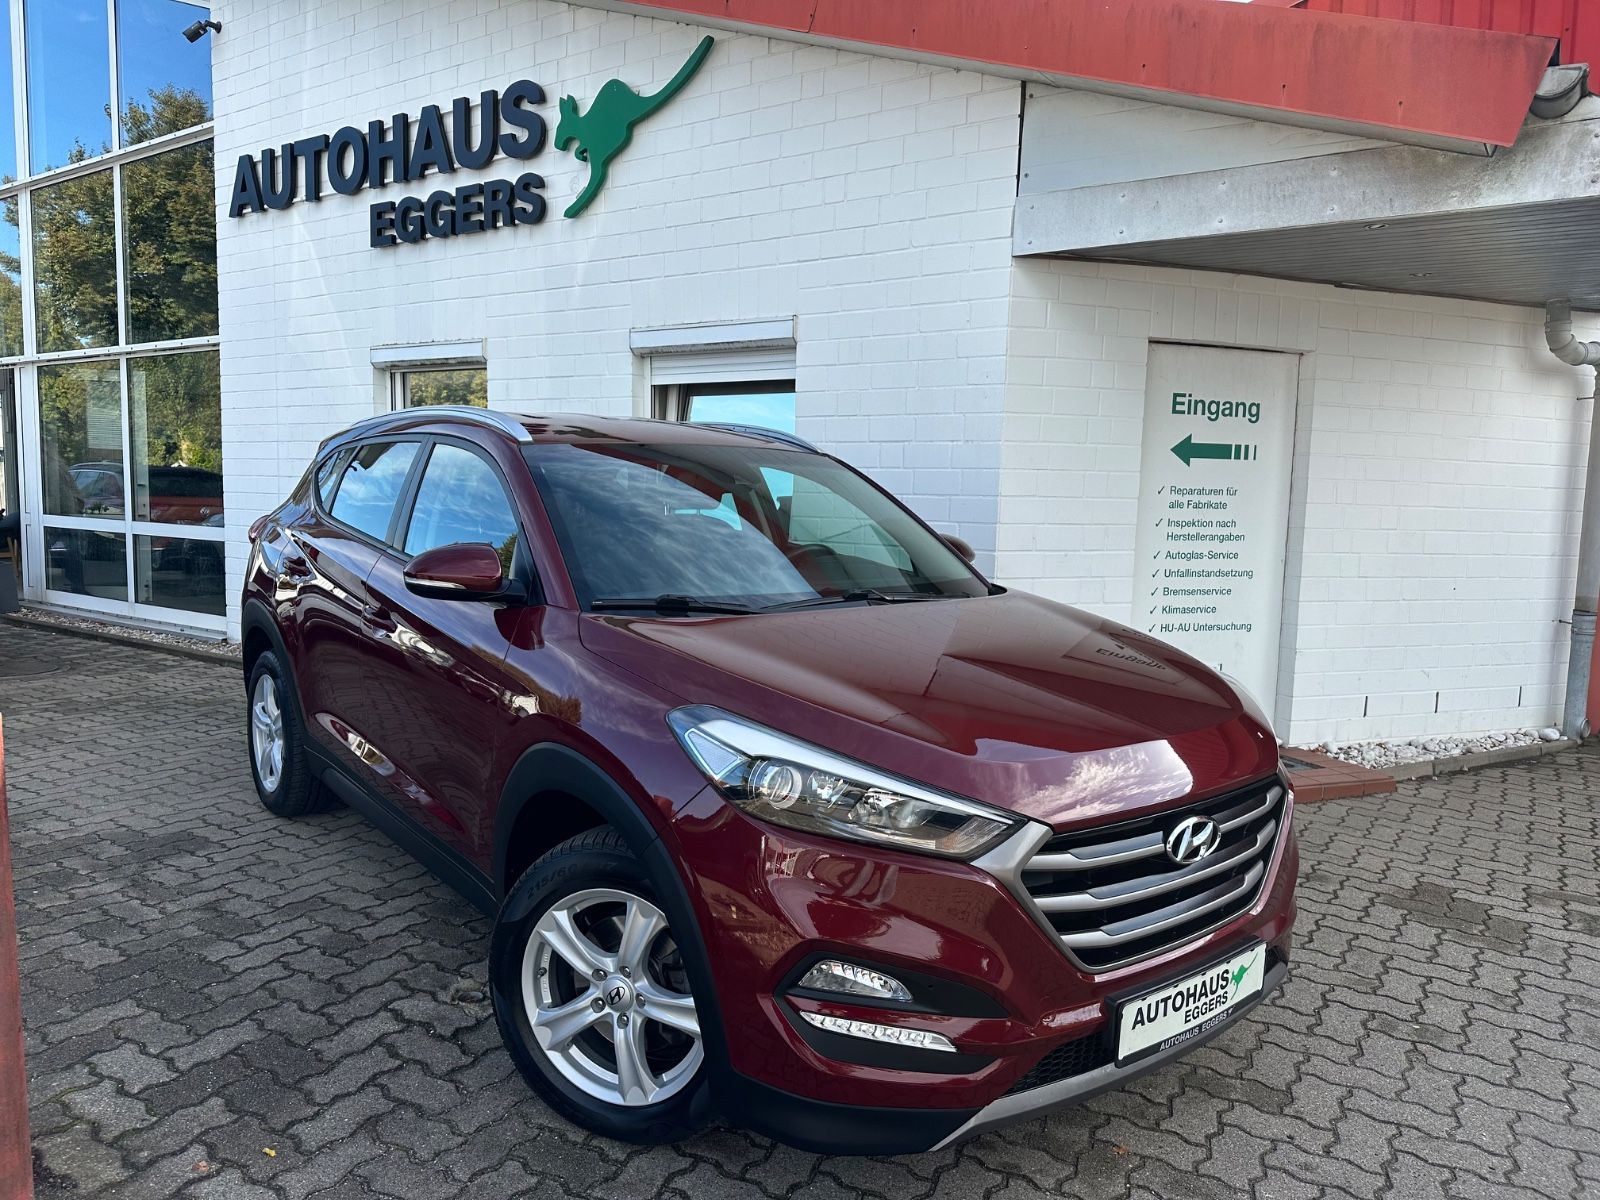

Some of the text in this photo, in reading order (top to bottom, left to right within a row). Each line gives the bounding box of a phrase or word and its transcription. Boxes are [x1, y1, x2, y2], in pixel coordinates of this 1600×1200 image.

[229, 79, 546, 218] AUTOHAUS
[369, 172, 546, 248] EGGERS
[1171, 392, 1261, 423] Eingang
[1169, 486, 1238, 497] Reparaturen für
[1168, 499, 1228, 509] alle Fabrikate
[1167, 518, 1236, 529] Inspektion nach
[1166, 532, 1245, 543] Herstellerangaben
[1165, 550, 1239, 561] Autoglas-Service
[1164, 568, 1253, 579] Unfallinstandsetzung
[1162, 586, 1232, 596] Bremsenservice
[1161, 605, 1217, 614] Klimaservice
[1160, 621, 1252, 632] HU-AU Untersuchung
[1131, 968, 1230, 1030] AUTOHAUS
[1184, 991, 1228, 1025] EGGERS
[1159, 1011, 1228, 1051] AUTOHAUS EGGERS
